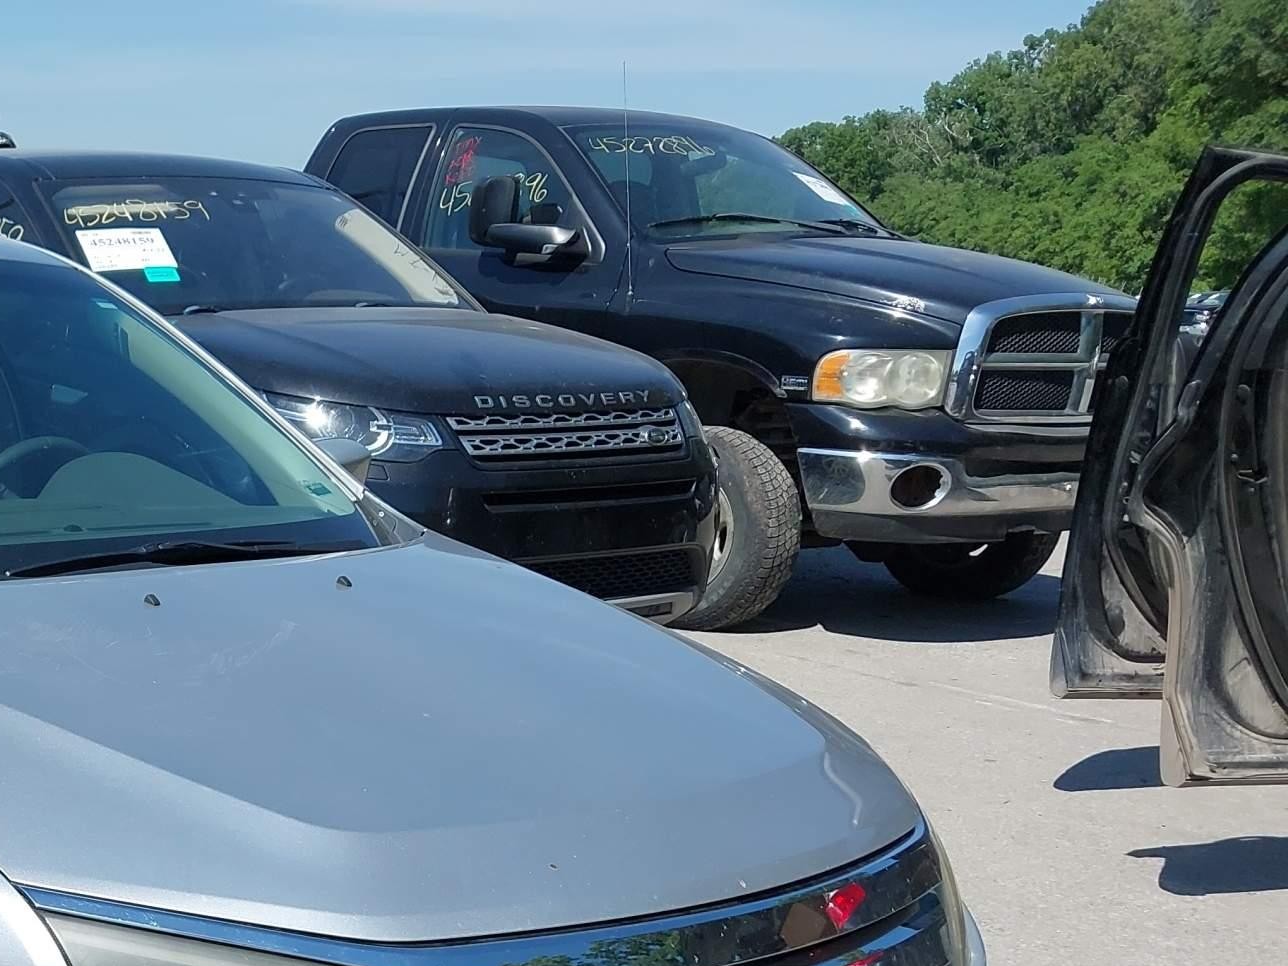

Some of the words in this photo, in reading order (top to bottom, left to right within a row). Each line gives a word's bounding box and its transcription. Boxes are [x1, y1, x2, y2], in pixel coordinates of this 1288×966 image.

[63, 199, 211, 228] 45248159
[89, 236, 155, 248] 45248159
[473, 389, 650, 409] DISCOVERY
